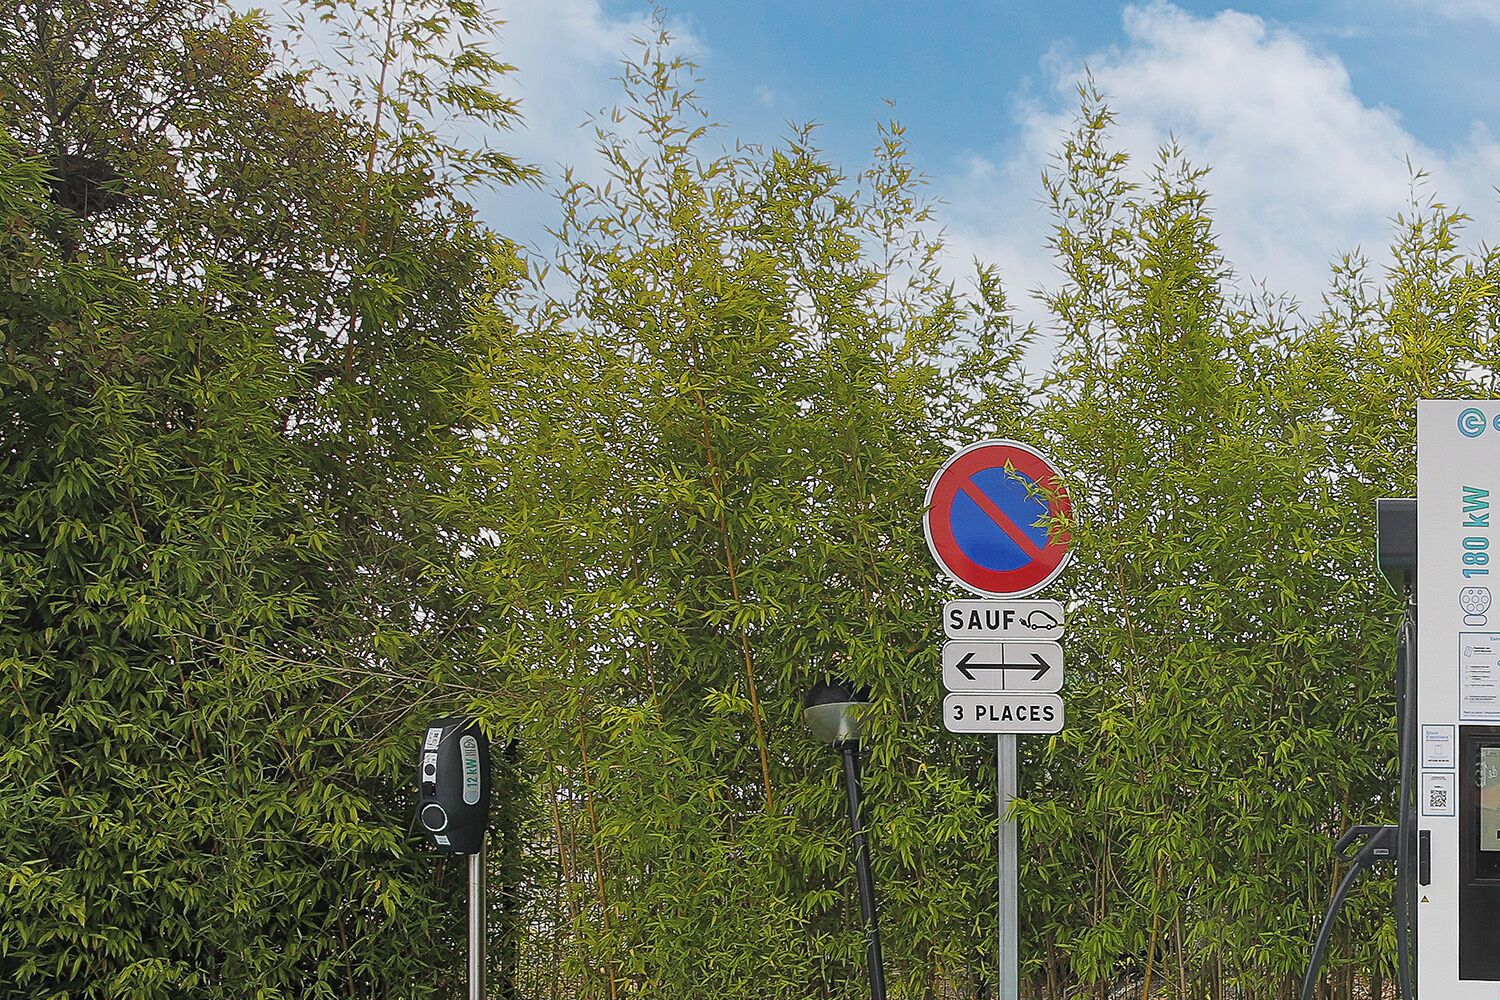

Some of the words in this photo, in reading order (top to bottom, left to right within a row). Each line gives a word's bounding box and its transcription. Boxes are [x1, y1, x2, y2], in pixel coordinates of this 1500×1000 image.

[1462, 486, 1490, 528] kW
[1462, 536, 1490, 579] 180
[949, 609, 1016, 630] SAUF
[953, 705, 964, 721] 3
[975, 705, 1055, 722] PLACES
[466, 758, 478, 775] kW
